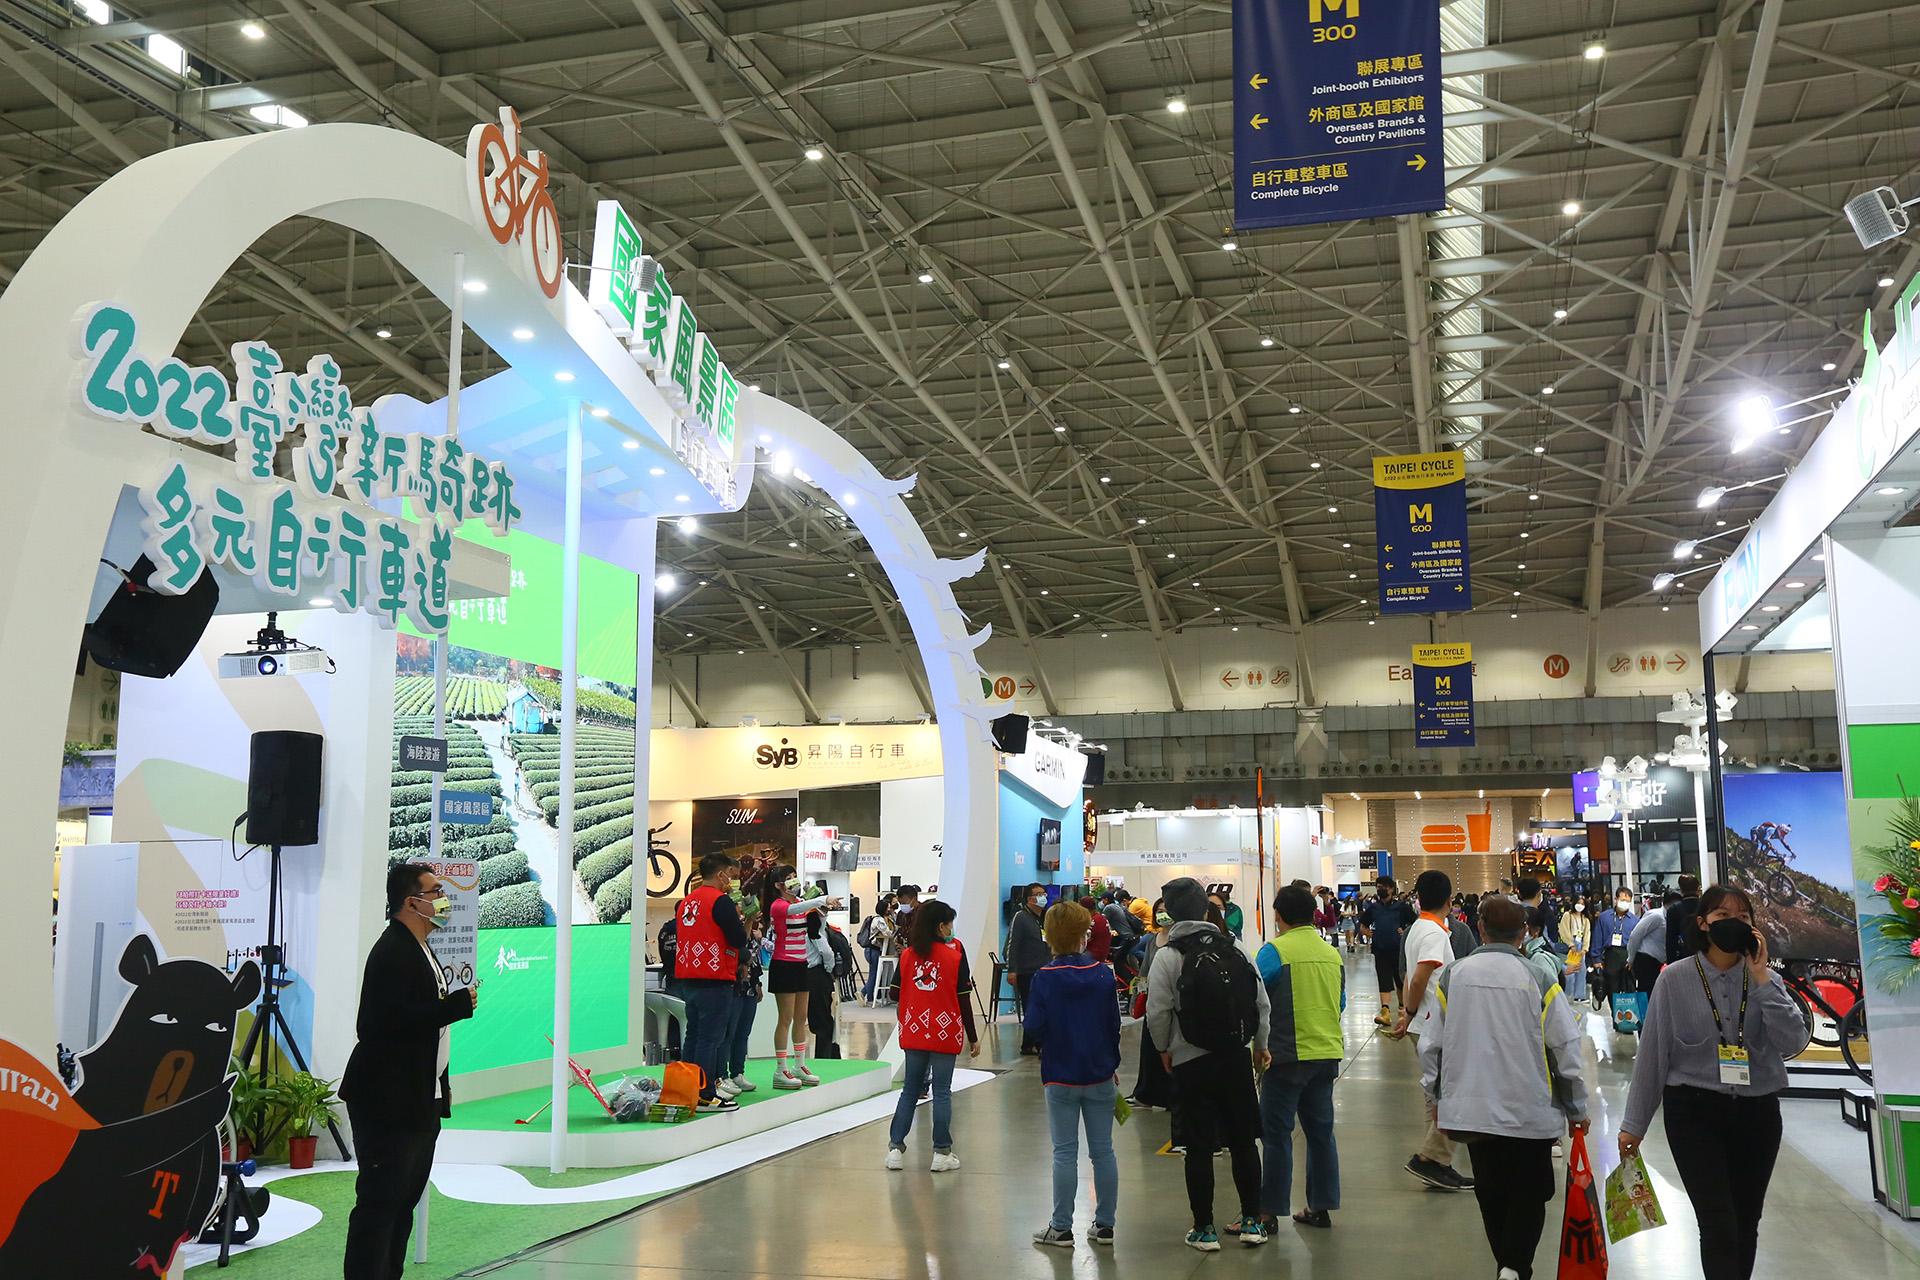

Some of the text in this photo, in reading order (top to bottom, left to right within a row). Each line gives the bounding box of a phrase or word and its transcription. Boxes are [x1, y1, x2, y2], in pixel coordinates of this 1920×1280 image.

[1312, 24, 1356, 43] 300
[1357, 54, 1424, 76] 聯展專區
[1312, 74, 1424, 95] Joint-booth Exhibitors
[1308, 96, 1424, 124] 外商區及國家館
[1326, 114, 1426, 134] Overseas Brands &
[1335, 127, 1426, 144] Country Pavilions
[1252, 162, 1348, 188] 自行車整車區
[1251, 183, 1339, 201] Complete Bicycle
[1384, 460, 1454, 474] TAIPEI CYCLE
[1409, 504, 1432, 524] M
[1412, 524, 1432, 532] 600
[155, 463, 452, 631] 多元自行車道
[1435, 676, 1450, 690] M
[808, 744, 904, 759] 昇陽自行車
[1034, 752, 1066, 780] GARMIN
[444, 800, 490, 816] 國家風景區
[726, 808, 759, 824] SUM
[805, 851, 826, 860] SRAM
[148, 1170, 180, 1219] T
